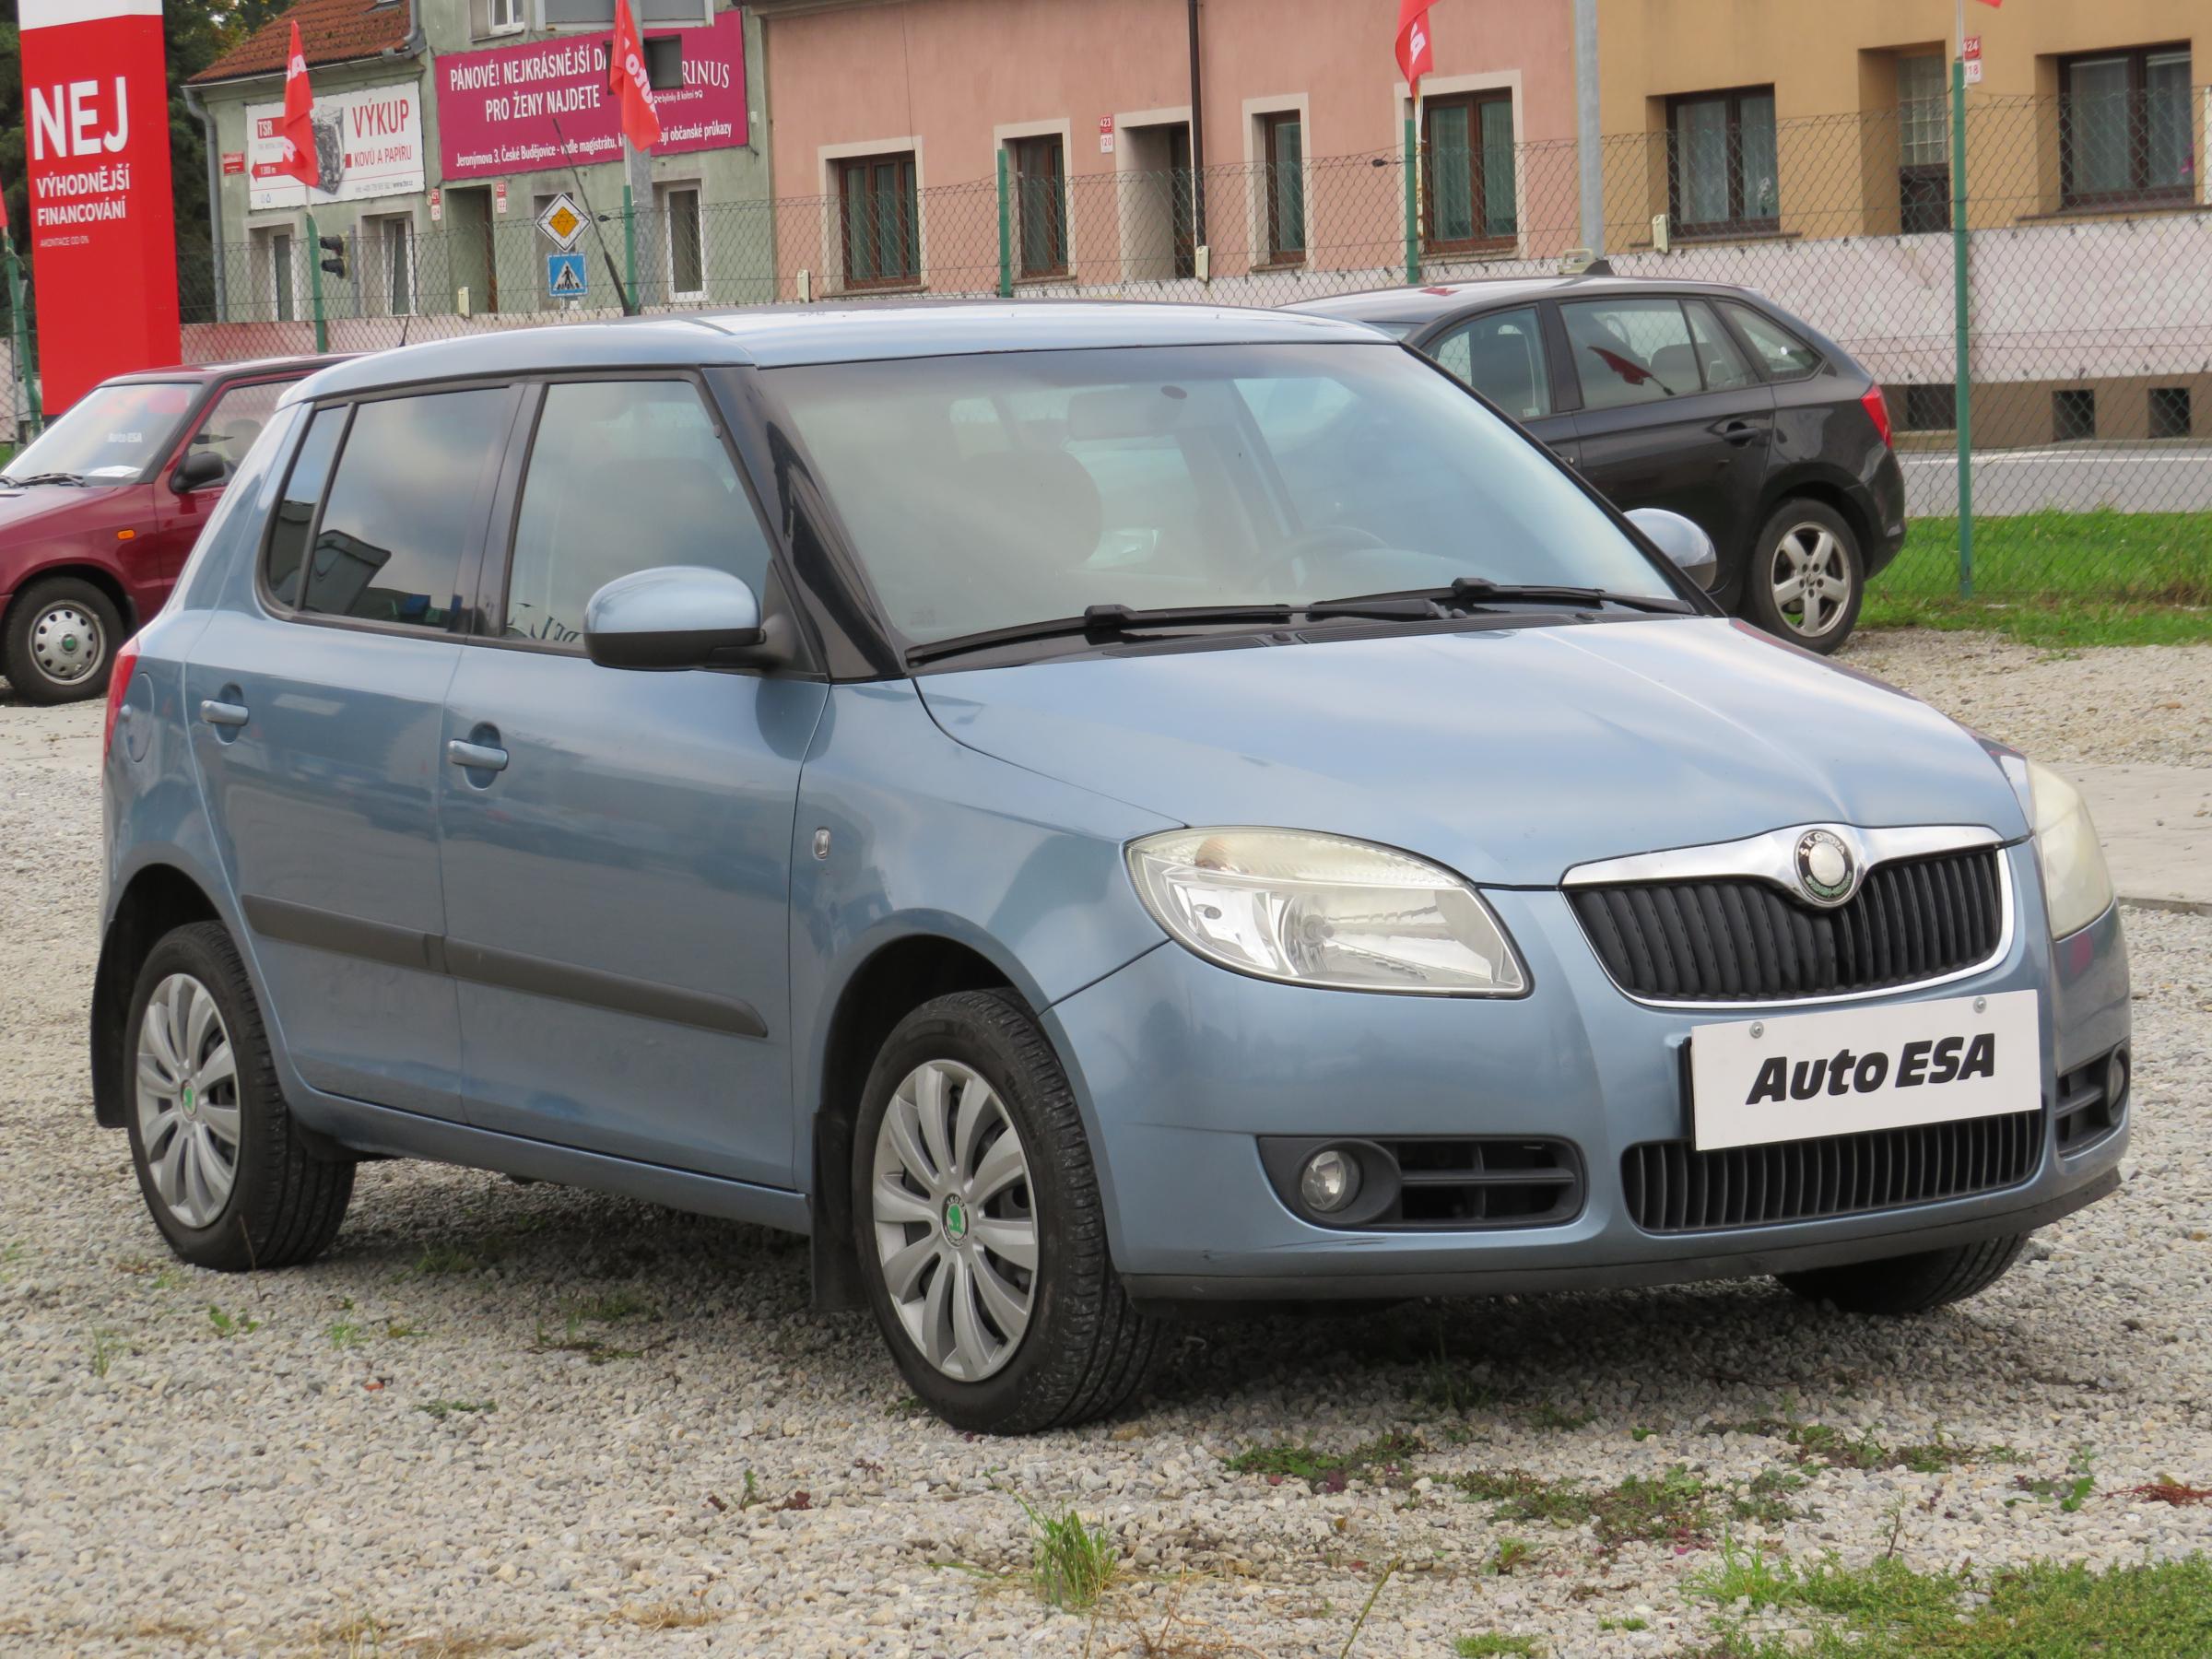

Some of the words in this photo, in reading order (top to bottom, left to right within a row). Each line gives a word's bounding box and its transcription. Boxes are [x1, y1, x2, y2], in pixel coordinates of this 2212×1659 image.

[450, 59, 500, 91] PÁNOVÉ!
[503, 44, 591, 85] NEJKRÁSNĚJŠÍ
[29, 76, 129, 161] NEJ
[352, 97, 409, 139] VÝKUP
[485, 98, 511, 123] PRO
[512, 89, 543, 120] ŽENY
[547, 84, 601, 114] NAJDETE
[257, 119, 273, 137] TSR
[670, 122, 703, 142] občanské
[704, 119, 732, 141] průkazy
[377, 148, 383, 165] A
[384, 144, 412, 164] PAPÍRU
[455, 151, 493, 170] Jeronýmova
[501, 144, 521, 162] České
[521, 142, 557, 162] Budějovice
[560, 138, 578, 155] vdle
[579, 135, 618, 156] magistrátu,
[36, 162, 131, 199] VÝHODNĚJŠÍ
[37, 194, 126, 228] FINANCOVÁNÍ
[1745, 1048, 1889, 1106] Auto
[1894, 1032, 1995, 1088] ESA
